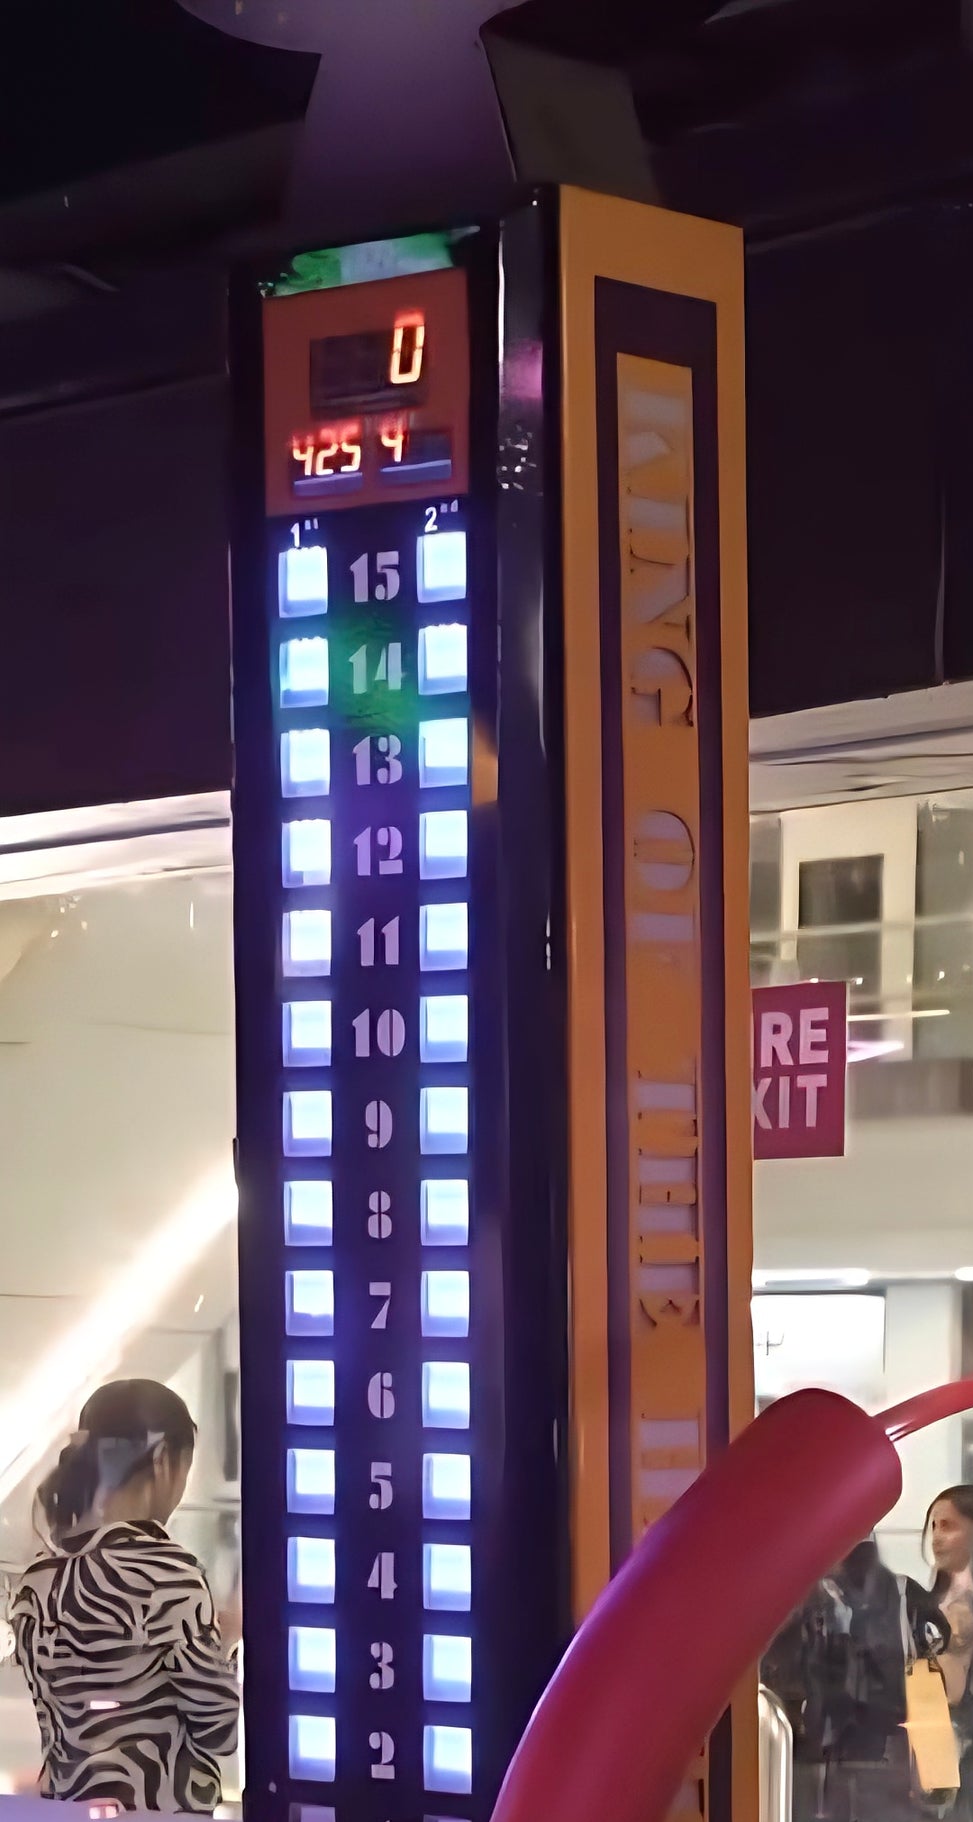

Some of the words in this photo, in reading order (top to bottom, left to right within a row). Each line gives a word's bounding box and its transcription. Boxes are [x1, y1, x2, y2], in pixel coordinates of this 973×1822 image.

[390, 312, 425, 384] 0
[292, 420, 361, 477] 425
[350, 552, 400, 602] 15
[348, 642, 402, 694] 14
[352, 734, 402, 785] 13
[353, 827, 403, 876] 12
[356, 917, 400, 966] 11
[352, 1009, 406, 1058] 10
[760, 1006, 829, 1068] RE
[365, 1101, 393, 1149] 9
[752, 1073, 828, 1130] XIT
[366, 1191, 392, 1239] 8
[368, 1282, 392, 1330] 7
[366, 1371, 394, 1420] 6
[368, 1462, 393, 1510] 5
[367, 1552, 397, 1600] 4
[369, 1642, 394, 1690] 3
[369, 1732, 395, 1779] 2
